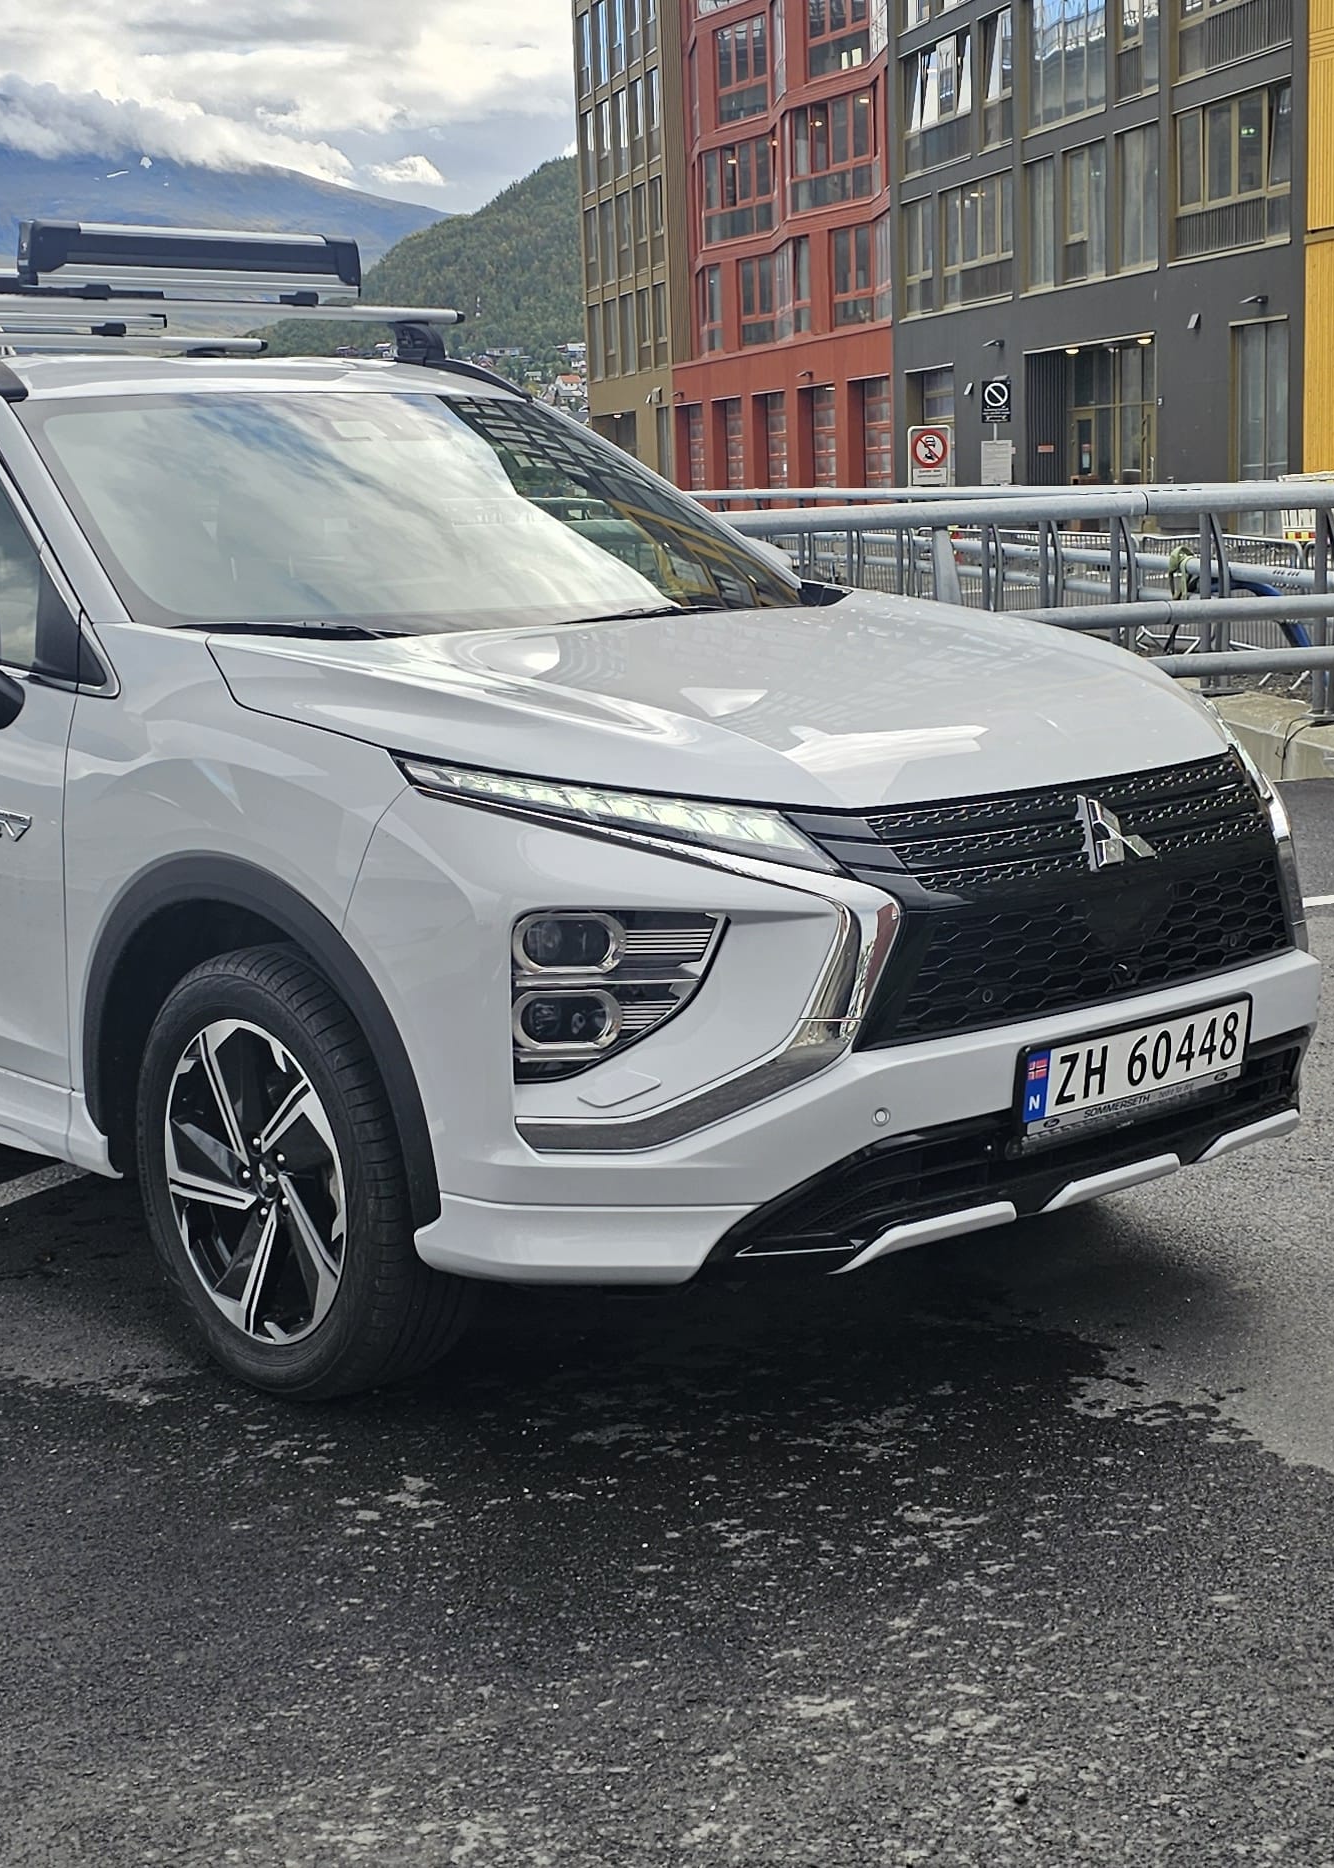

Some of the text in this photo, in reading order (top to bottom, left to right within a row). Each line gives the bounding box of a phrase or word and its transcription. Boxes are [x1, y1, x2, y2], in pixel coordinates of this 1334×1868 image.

[1054, 1011, 1239, 1106] ZH 60448
[1029, 1094, 1040, 1112] N
[1084, 1094, 1150, 1119] SOMMERSETH
